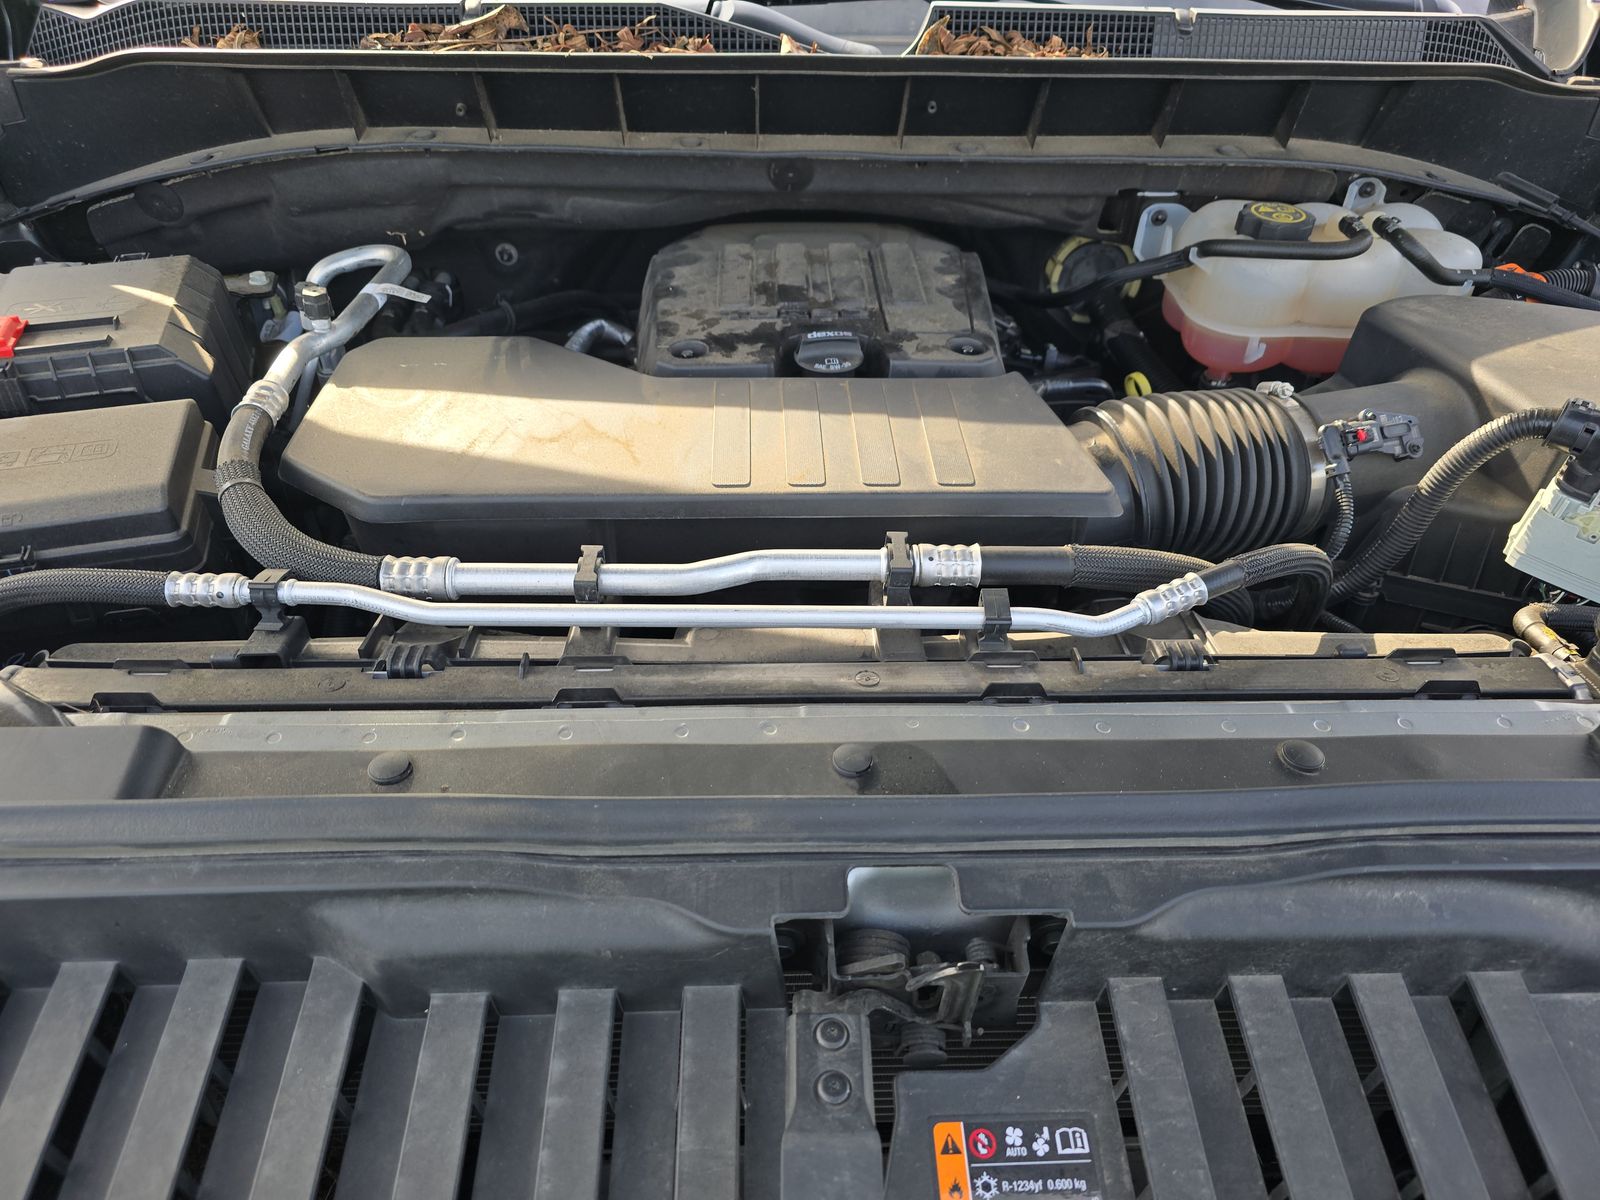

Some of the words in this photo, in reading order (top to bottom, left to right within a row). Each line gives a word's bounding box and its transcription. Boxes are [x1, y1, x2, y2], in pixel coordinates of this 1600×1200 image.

[807, 331, 852, 339] dexos
[1005, 1146, 1028, 1157] AUTO
[1002, 1179, 1042, 1193] R-1234yf
[1046, 1178, 1073, 1191] 0.600
[1073, 1177, 1087, 1192] kg
